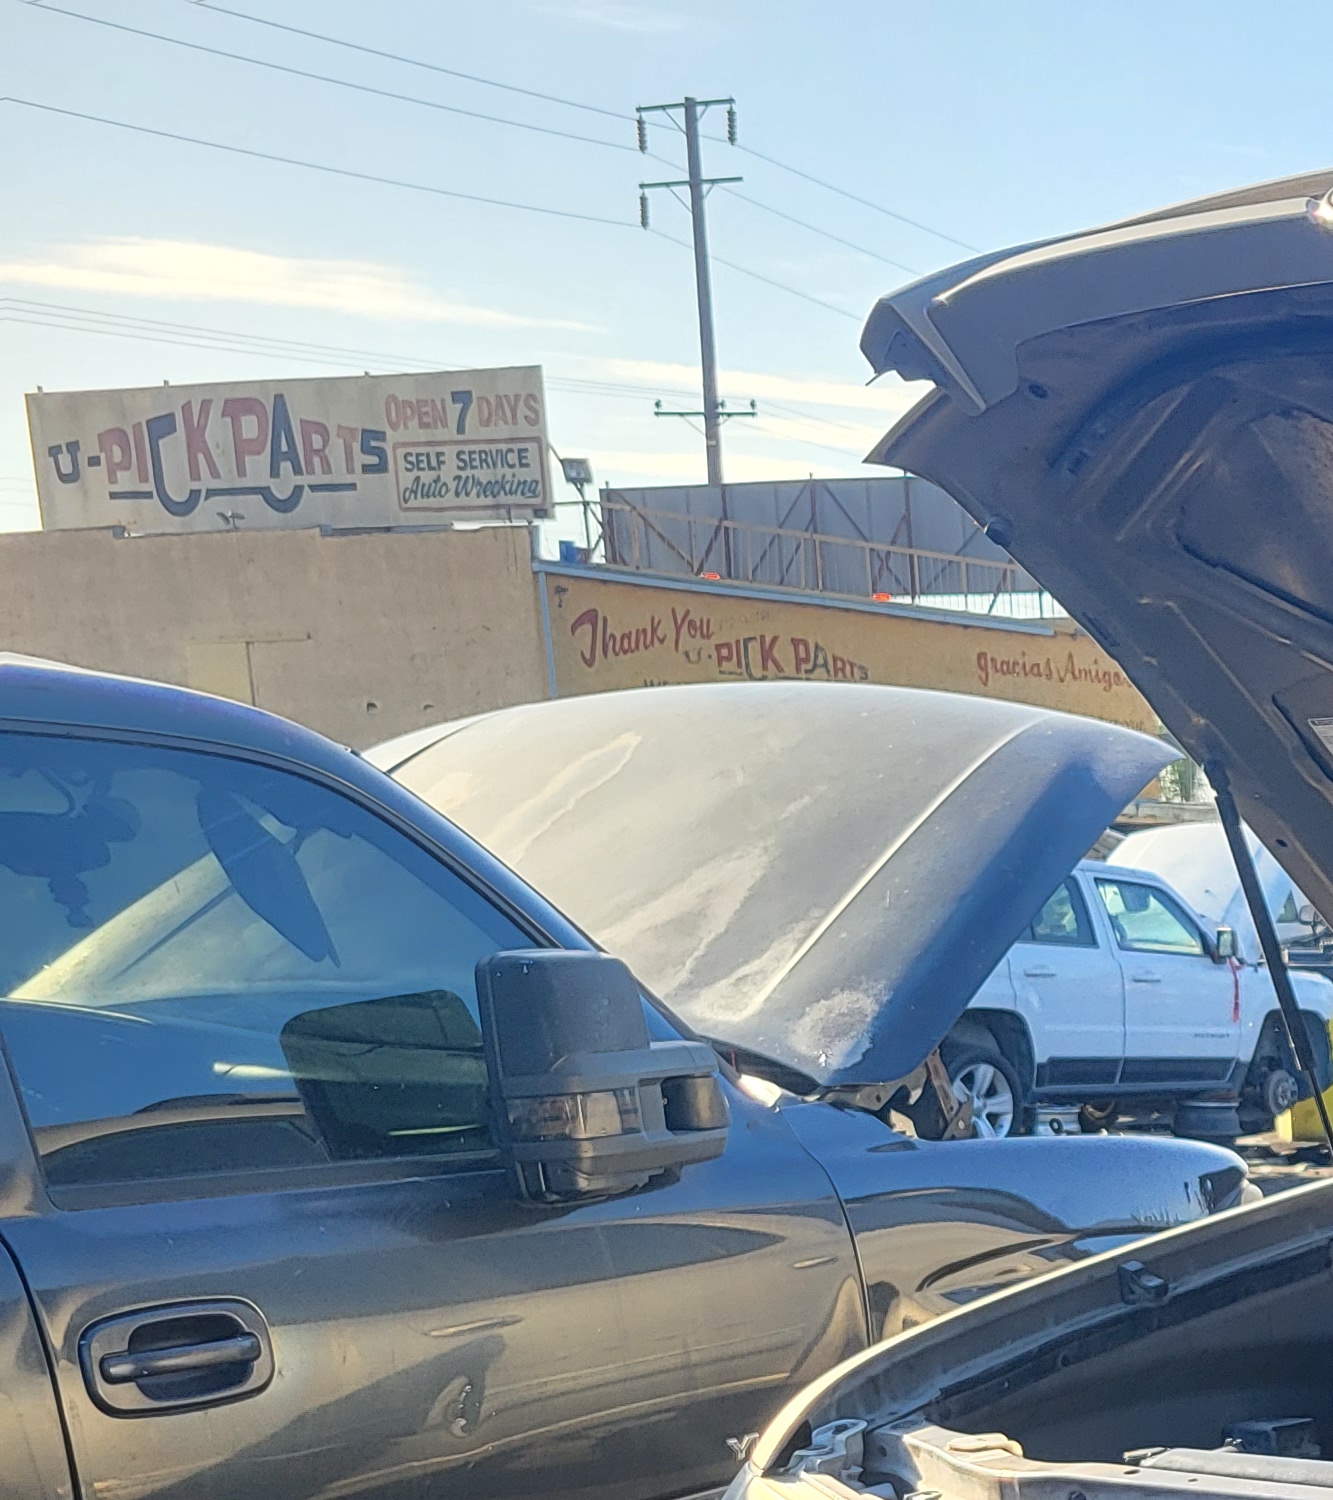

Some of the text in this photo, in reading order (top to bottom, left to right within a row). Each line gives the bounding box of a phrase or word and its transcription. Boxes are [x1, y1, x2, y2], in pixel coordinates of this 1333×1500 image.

[385, 390, 540, 435] OPEN 7 DAYS
[221, 393, 389, 479] PARTS
[403, 447, 531, 473] SELF SERVICE
[402, 472, 540, 505] Auto Wrecking
[570, 608, 667, 669] Thank
[671, 606, 714, 652] You
[790, 636, 869, 680] PARTS
